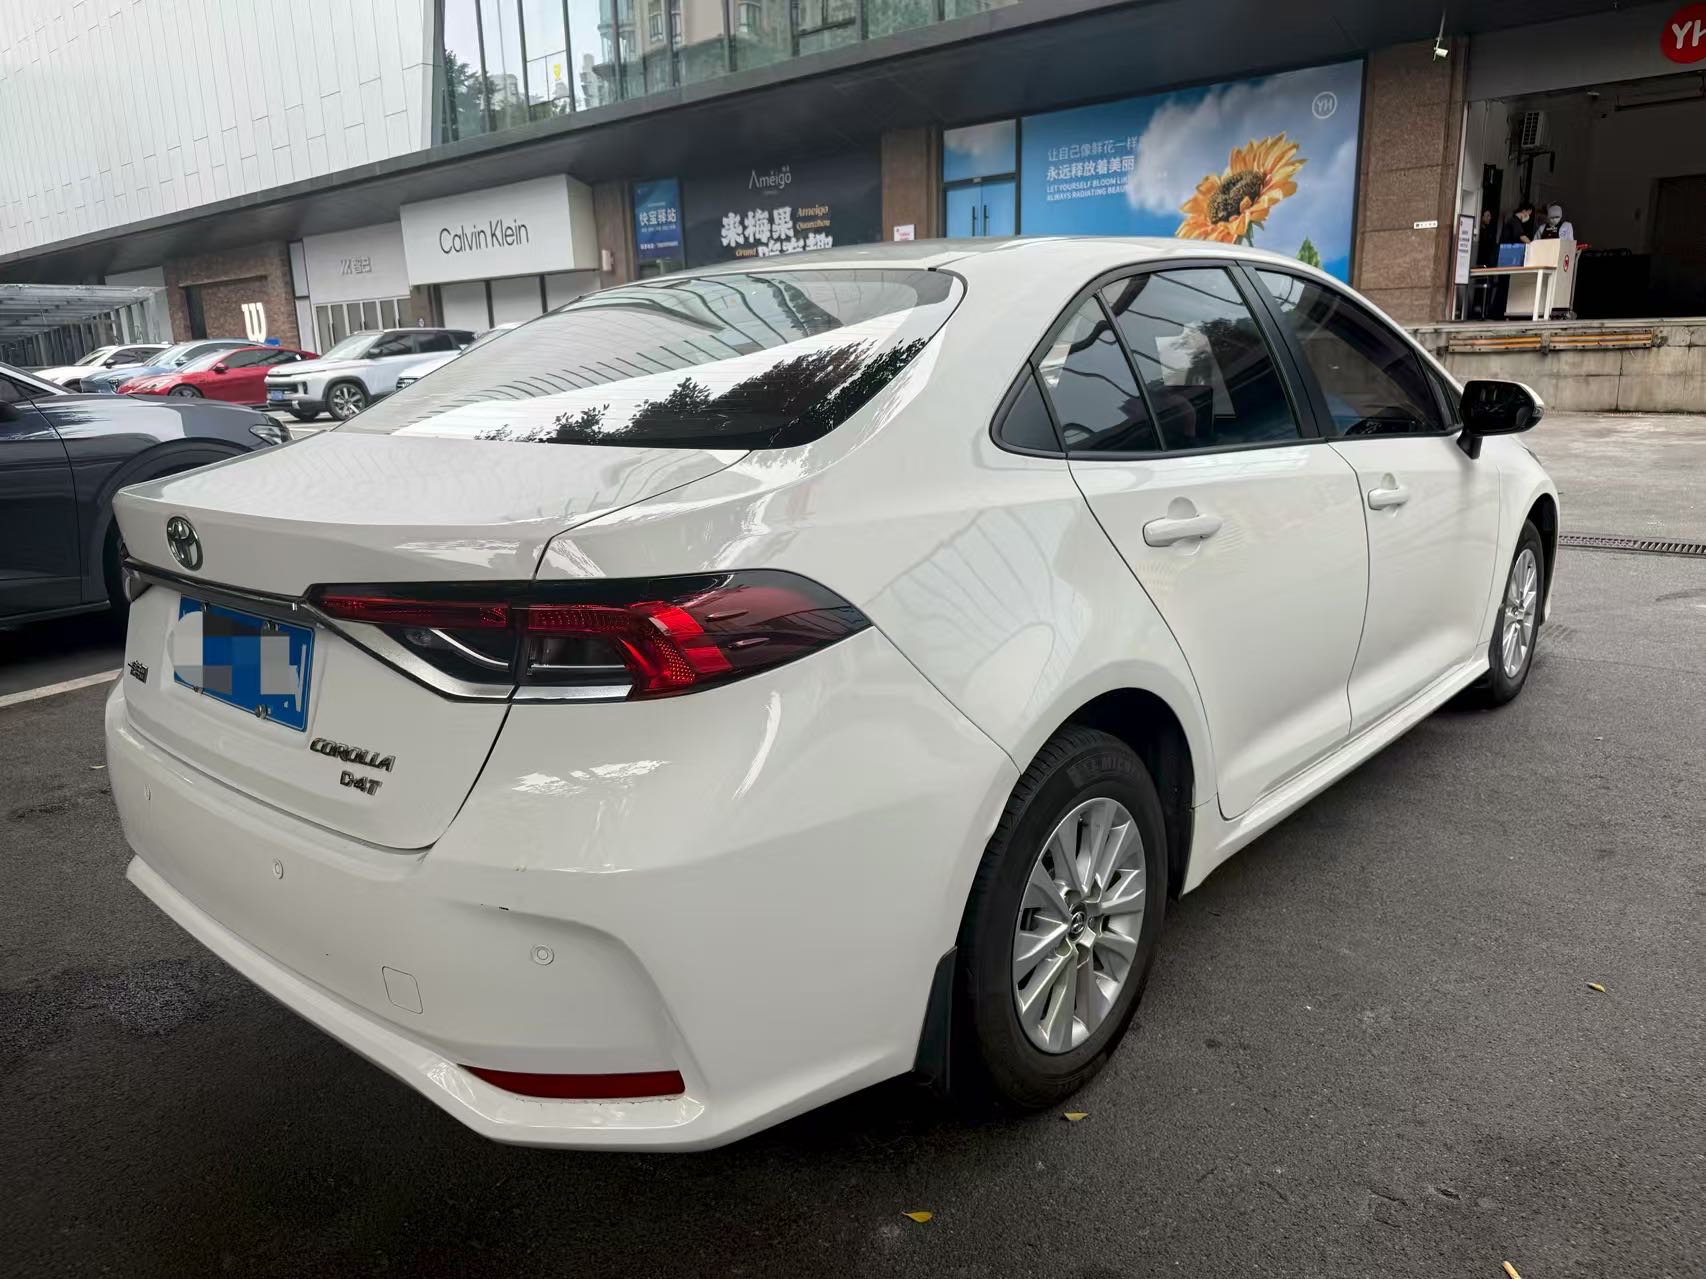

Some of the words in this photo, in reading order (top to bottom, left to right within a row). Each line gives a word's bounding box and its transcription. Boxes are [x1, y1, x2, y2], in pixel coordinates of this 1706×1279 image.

[748, 169, 791, 190] Ameigo
[1046, 155, 1135, 180] 永远释放着美丽
[439, 224, 488, 254] Calvin
[489, 219, 529, 247] Klein
[310, 737, 396, 773] COROLLA
